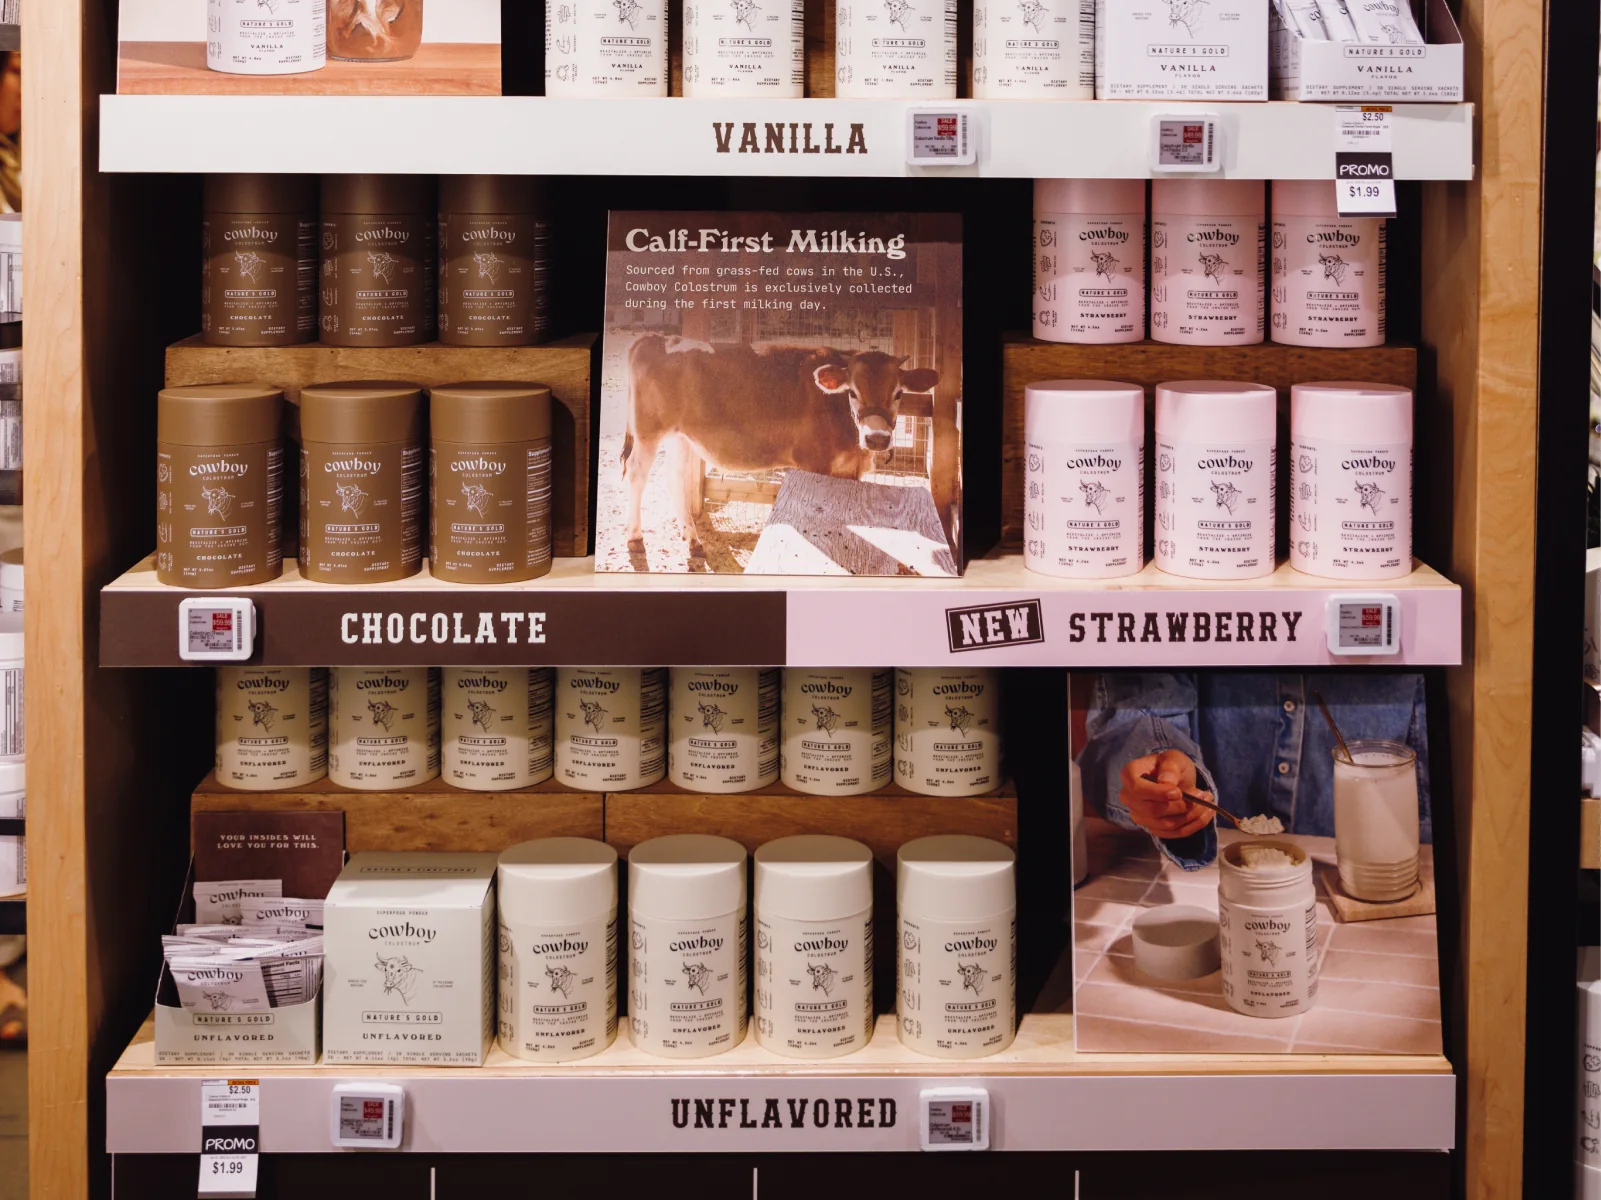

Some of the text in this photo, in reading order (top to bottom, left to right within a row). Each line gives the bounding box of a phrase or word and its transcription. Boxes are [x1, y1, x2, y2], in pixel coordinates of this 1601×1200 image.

[1363, 113, 1384, 121] $2.50
[713, 123, 867, 154] VANILLA
[1340, 164, 1389, 175] PROMO
[1350, 186, 1379, 197] $1.99
[224, 227, 278, 243] cowboy
[356, 227, 409, 243] cowboy
[462, 227, 516, 243] cowboy
[1079, 228, 1129, 243] cowboy
[1187, 229, 1239, 245] cowboy
[1306, 229, 1360, 245] cowboy
[626, 229, 906, 259] Calf-First Milking
[626, 265, 904, 279] Sourced from grass-fed cows in the U.S.,
[625, 281, 912, 295] Cowboy Colostrum is exclusively collected
[625, 298, 827, 312] during the first milking day.
[189, 460, 248, 477] cowboy
[324, 458, 381, 474] cowboy
[451, 458, 506, 474] cowboy
[1067, 455, 1121, 471] cowboy
[1198, 456, 1252, 472] cowboy
[1342, 456, 1395, 472] cowboy
[341, 613, 545, 643] CHOCOLATE
[960, 607, 1030, 645] NEW
[1069, 612, 1302, 642] STRAWBERRY
[238, 676, 289, 691] cowboy
[356, 676, 409, 691] cowboy
[458, 676, 507, 692] cowboy
[571, 677, 620, 693] cowboy
[688, 680, 738, 696] cowboy
[801, 682, 852, 698] cowboy
[933, 682, 984, 697] cowboy
[256, 907, 310, 920] cowboy
[369, 922, 436, 943] cowboy
[1245, 920, 1290, 933] cowboy
[533, 939, 588, 954] cowboy
[670, 936, 723, 952] cowboy
[794, 937, 848, 952] cowboy
[945, 937, 997, 952] cowboy
[188, 968, 243, 982] cowboy
[536, 1029, 585, 1037] UNFLAVORED
[673, 1024, 721, 1033] UNFLAVORED
[798, 1026, 846, 1034] UNFLAVORED
[948, 1025, 995, 1034] UNFLAVORED
[229, 1086, 251, 1094] $2.50
[671, 1098, 896, 1128] UNFLAVORED
[205, 1138, 255, 1150] PROMO
[213, 1162, 243, 1174] $1.99
